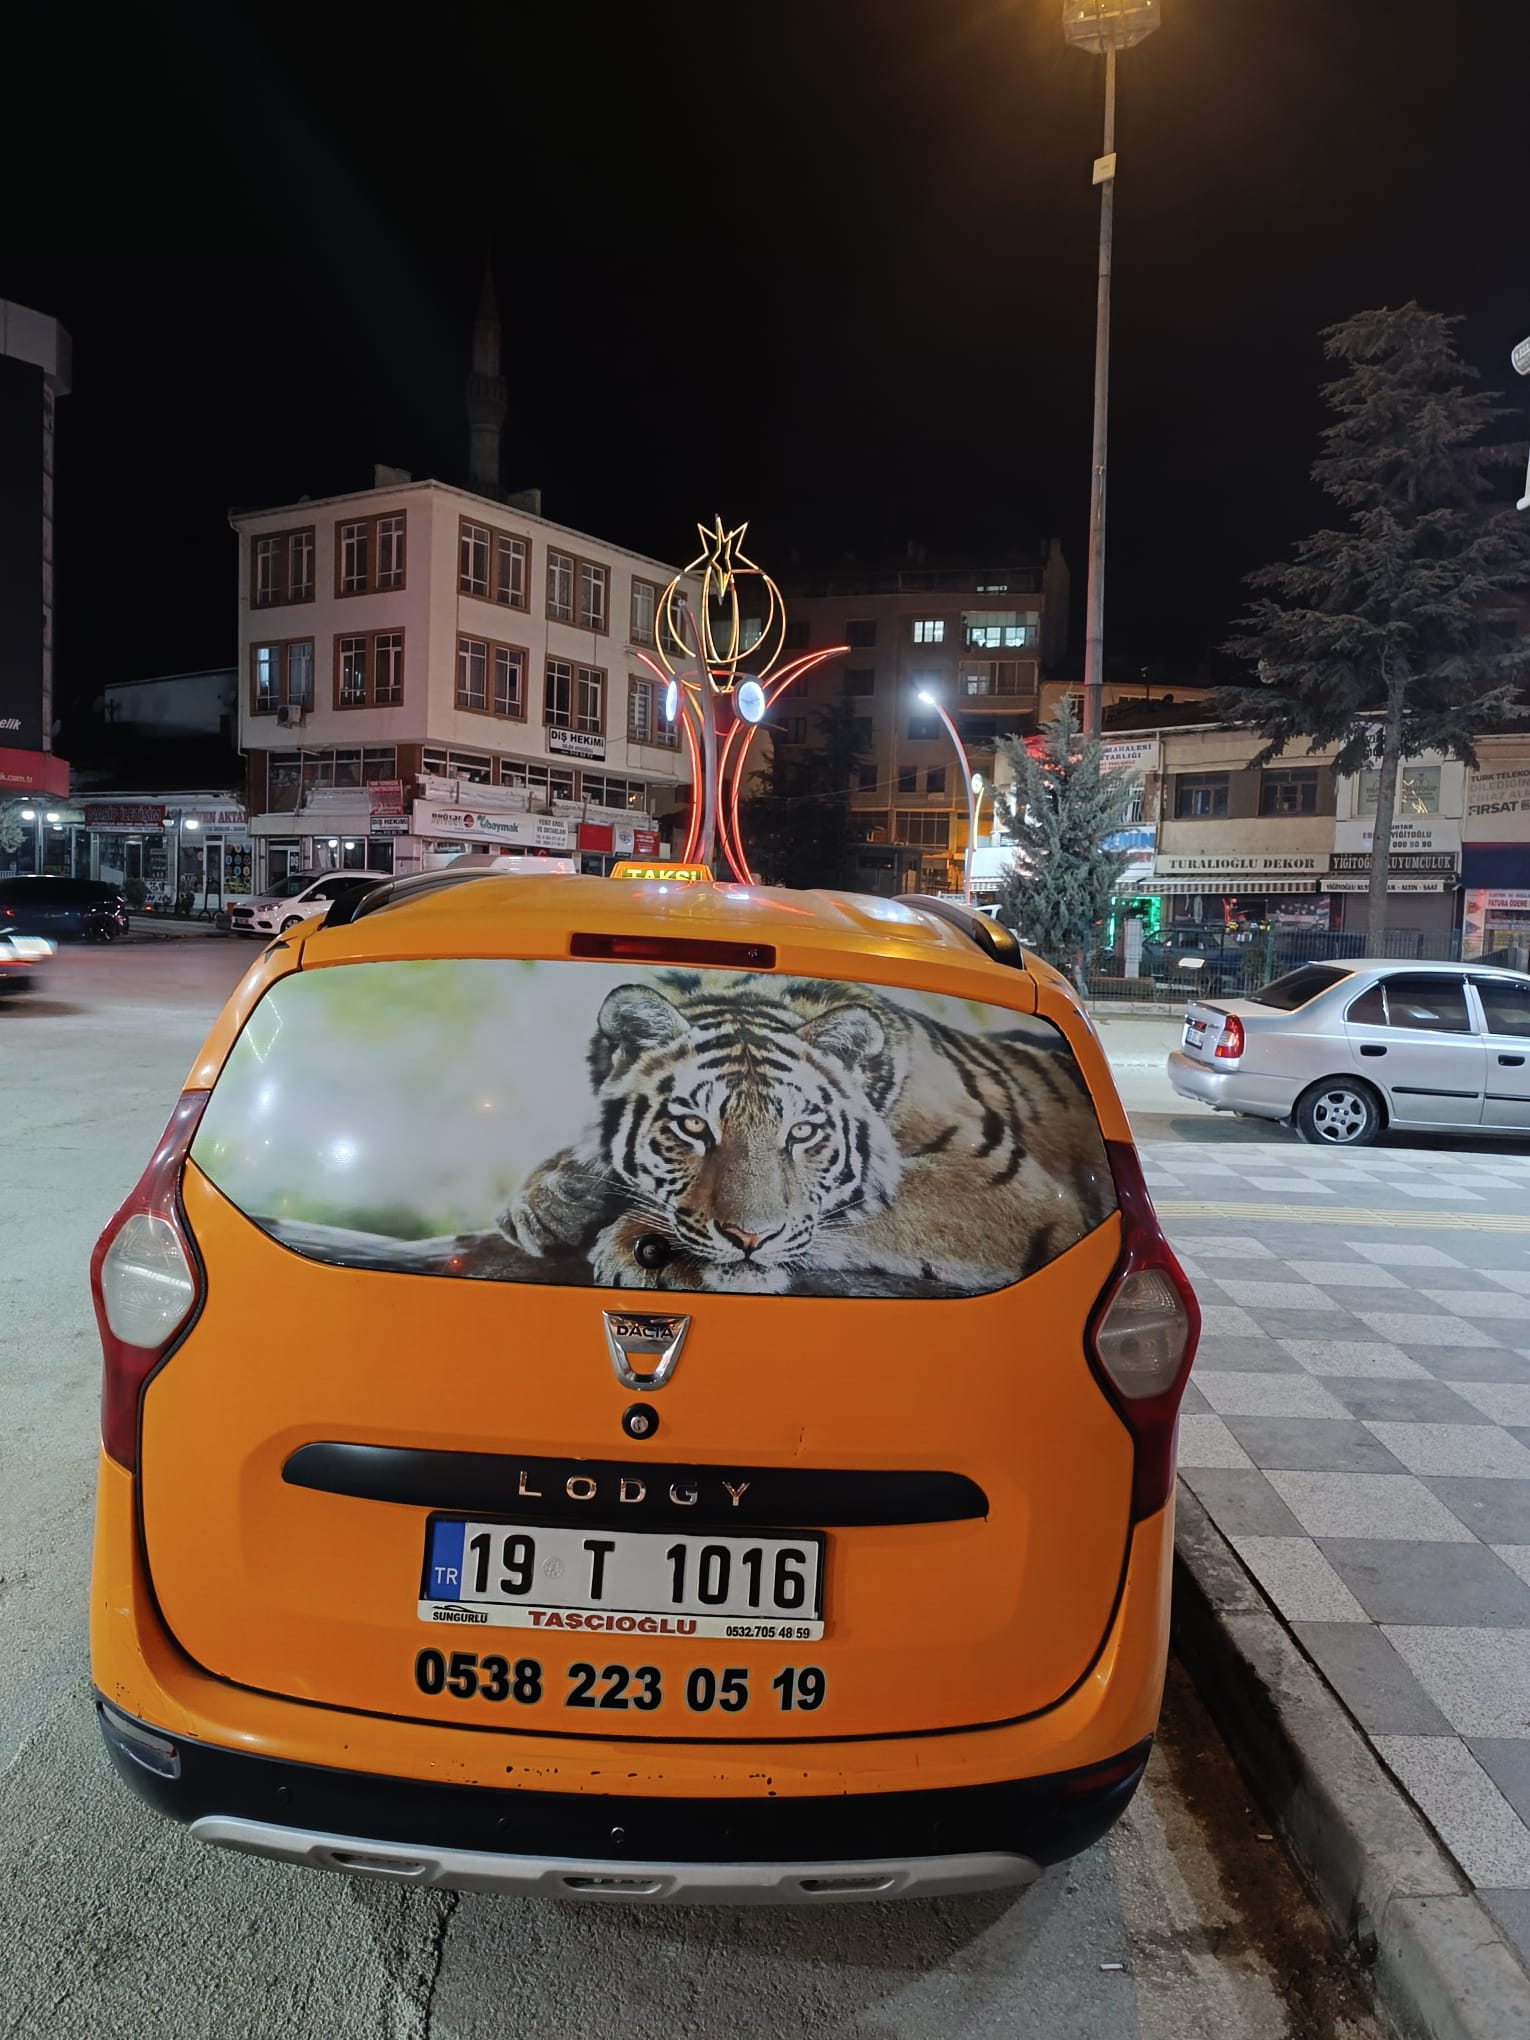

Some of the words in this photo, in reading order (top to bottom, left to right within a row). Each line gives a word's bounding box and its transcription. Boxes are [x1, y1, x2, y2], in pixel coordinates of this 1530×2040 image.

[1263, 858, 1315, 869] DEKOR
[1333, 853, 1373, 870] YİĞİTOĞ
[616, 1325, 675, 1338] DACIA
[518, 1470, 750, 1507] LODGY
[434, 1566, 458, 1585] TR
[470, 1533, 536, 1596] 19
[583, 1539, 616, 1600] T
[666, 1543, 806, 1609] 1016
[432, 1611, 488, 1624] SUNGURLU
[528, 1610, 697, 1634] TAŞÇIOĞLU
[778, 1626, 793, 1639] 48
[796, 1627, 810, 1640] 59
[415, 1648, 542, 1705] 0538
[565, 1662, 663, 1711] 223
[686, 1666, 750, 1713] 05
[771, 1665, 826, 1713] 19
